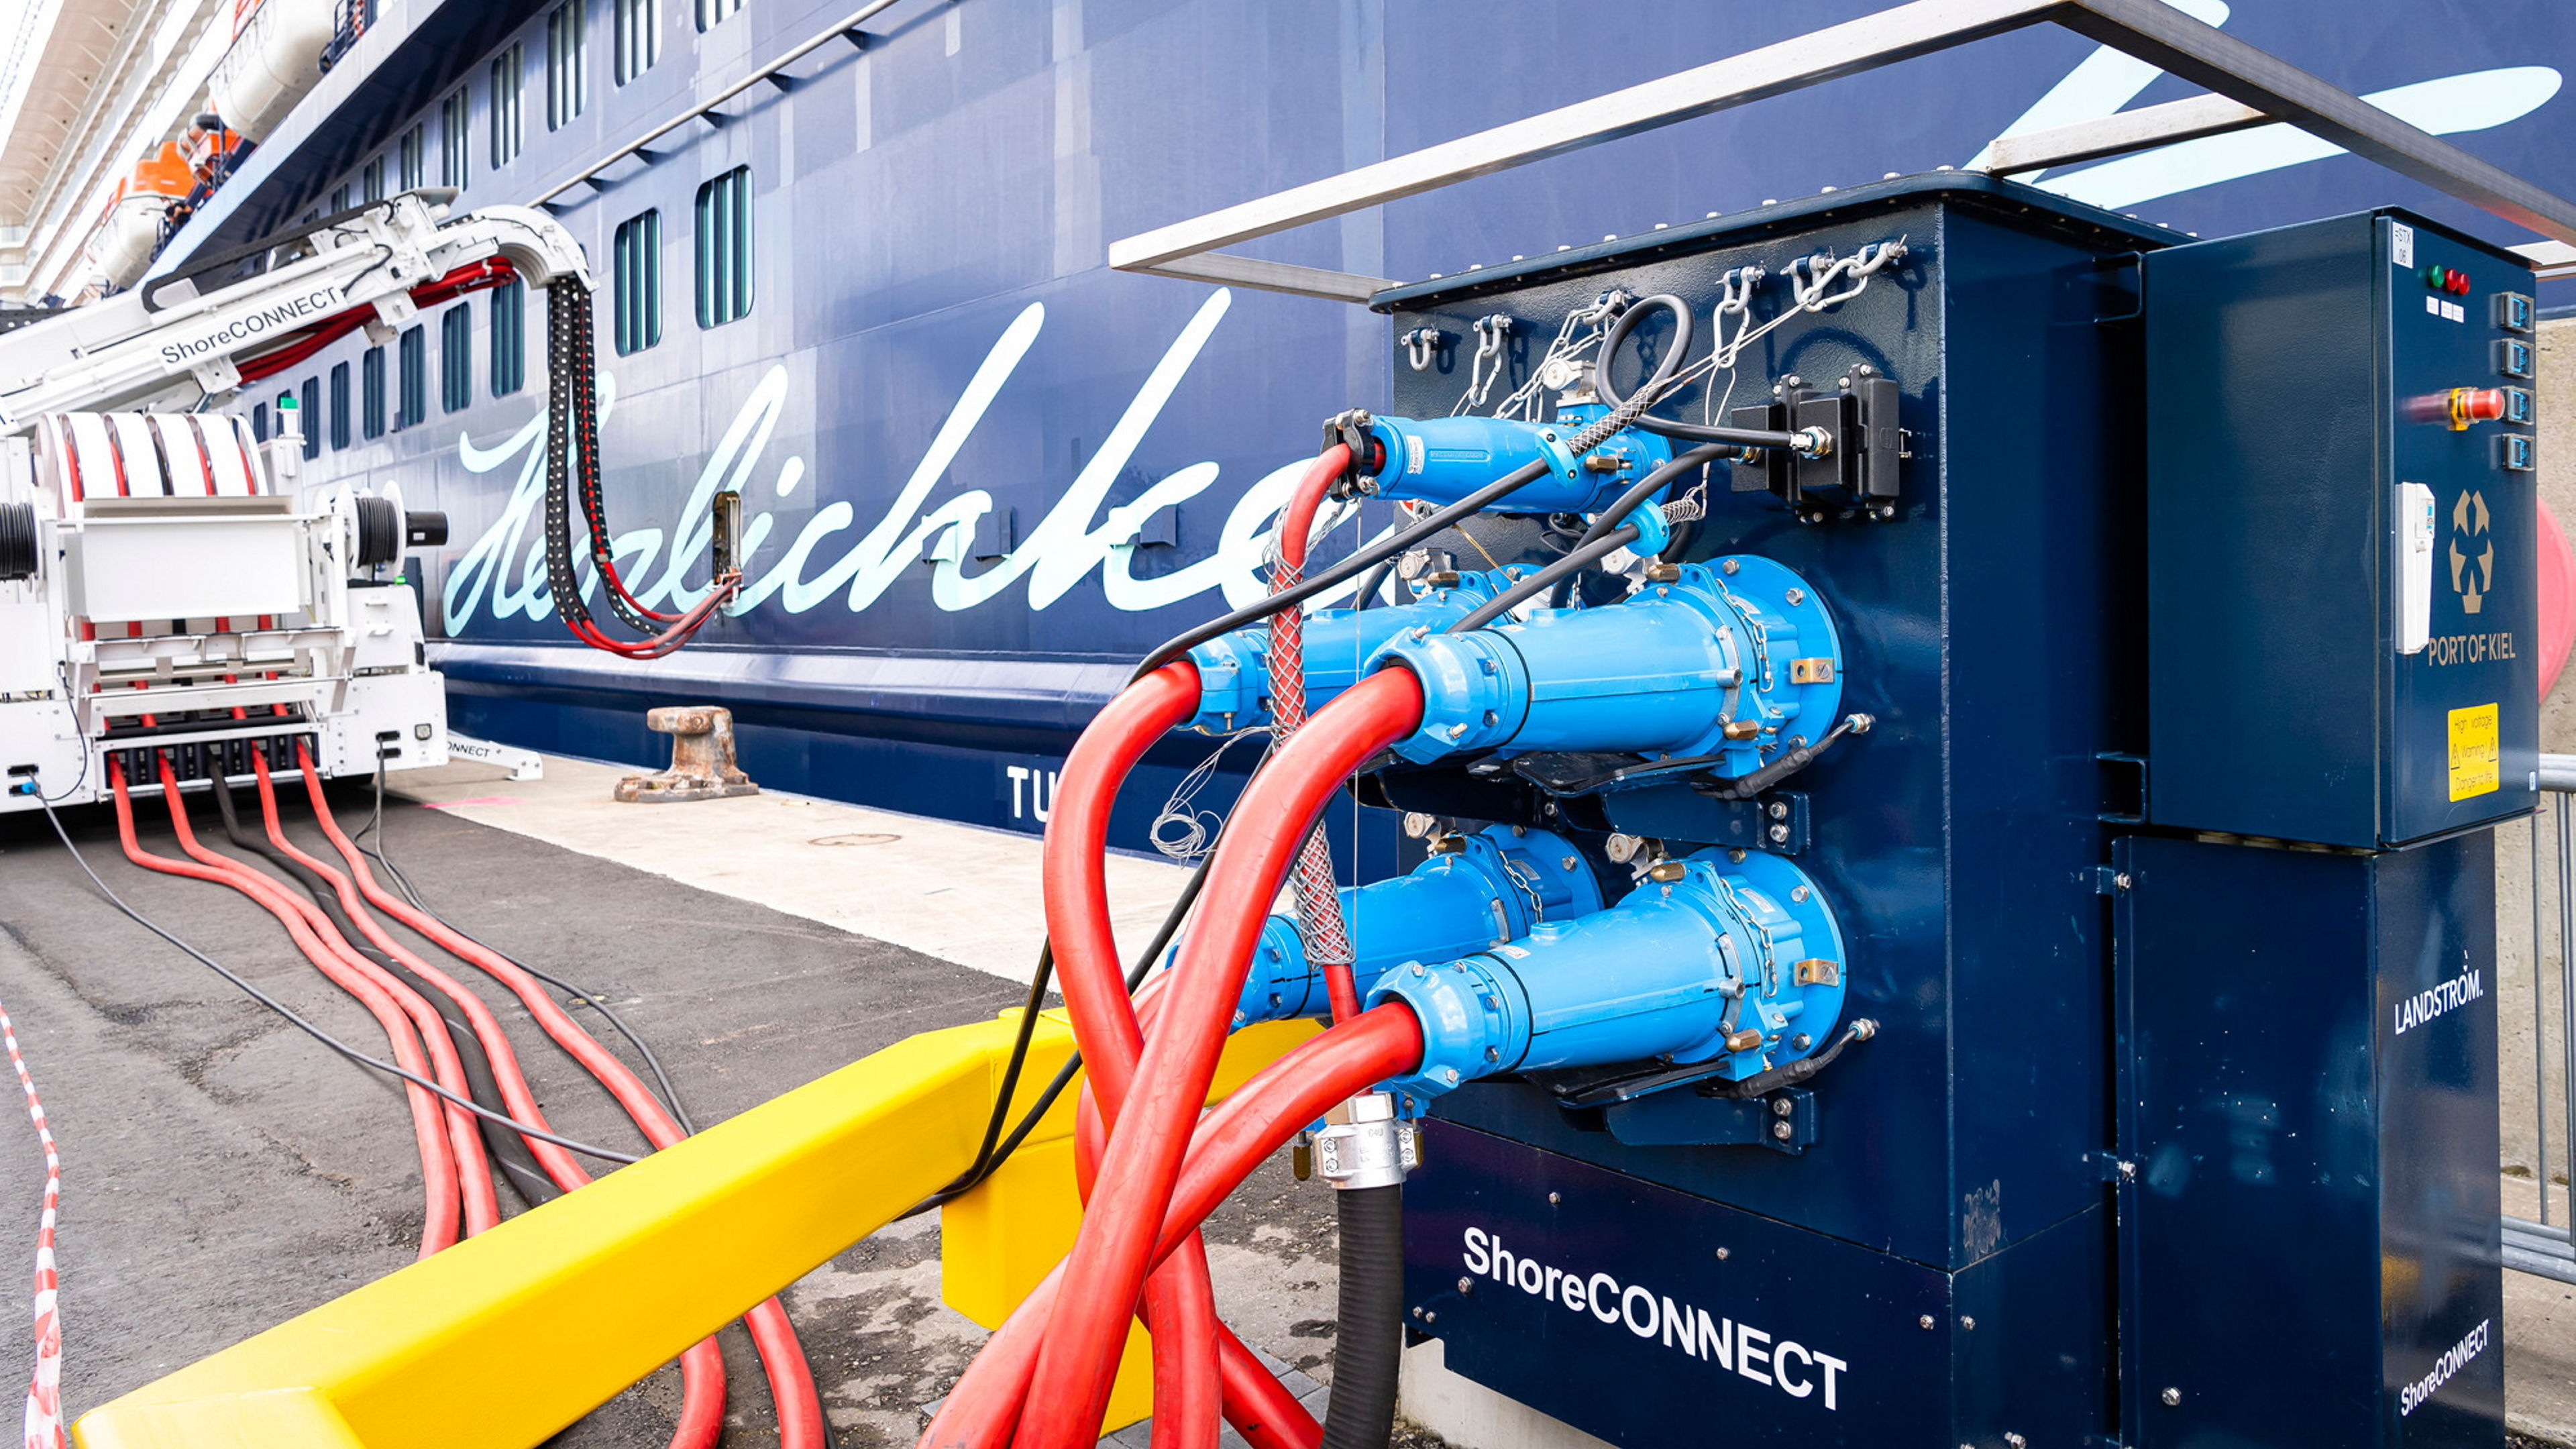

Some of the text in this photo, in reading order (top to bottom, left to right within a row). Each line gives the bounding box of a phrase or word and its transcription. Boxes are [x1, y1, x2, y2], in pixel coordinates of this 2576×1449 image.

[162, 286, 339, 363] ShoreCONNECT
[2428, 632, 2516, 666] PORT OF KIEL
[447, 739, 490, 757] ONNECT
[2455, 714, 2492, 733] High voltage
[1007, 765, 1056, 822] TU
[1462, 1226, 1847, 1411] ShoreCONNECT
[2401, 1318, 2489, 1416] ShoreCONNECT
